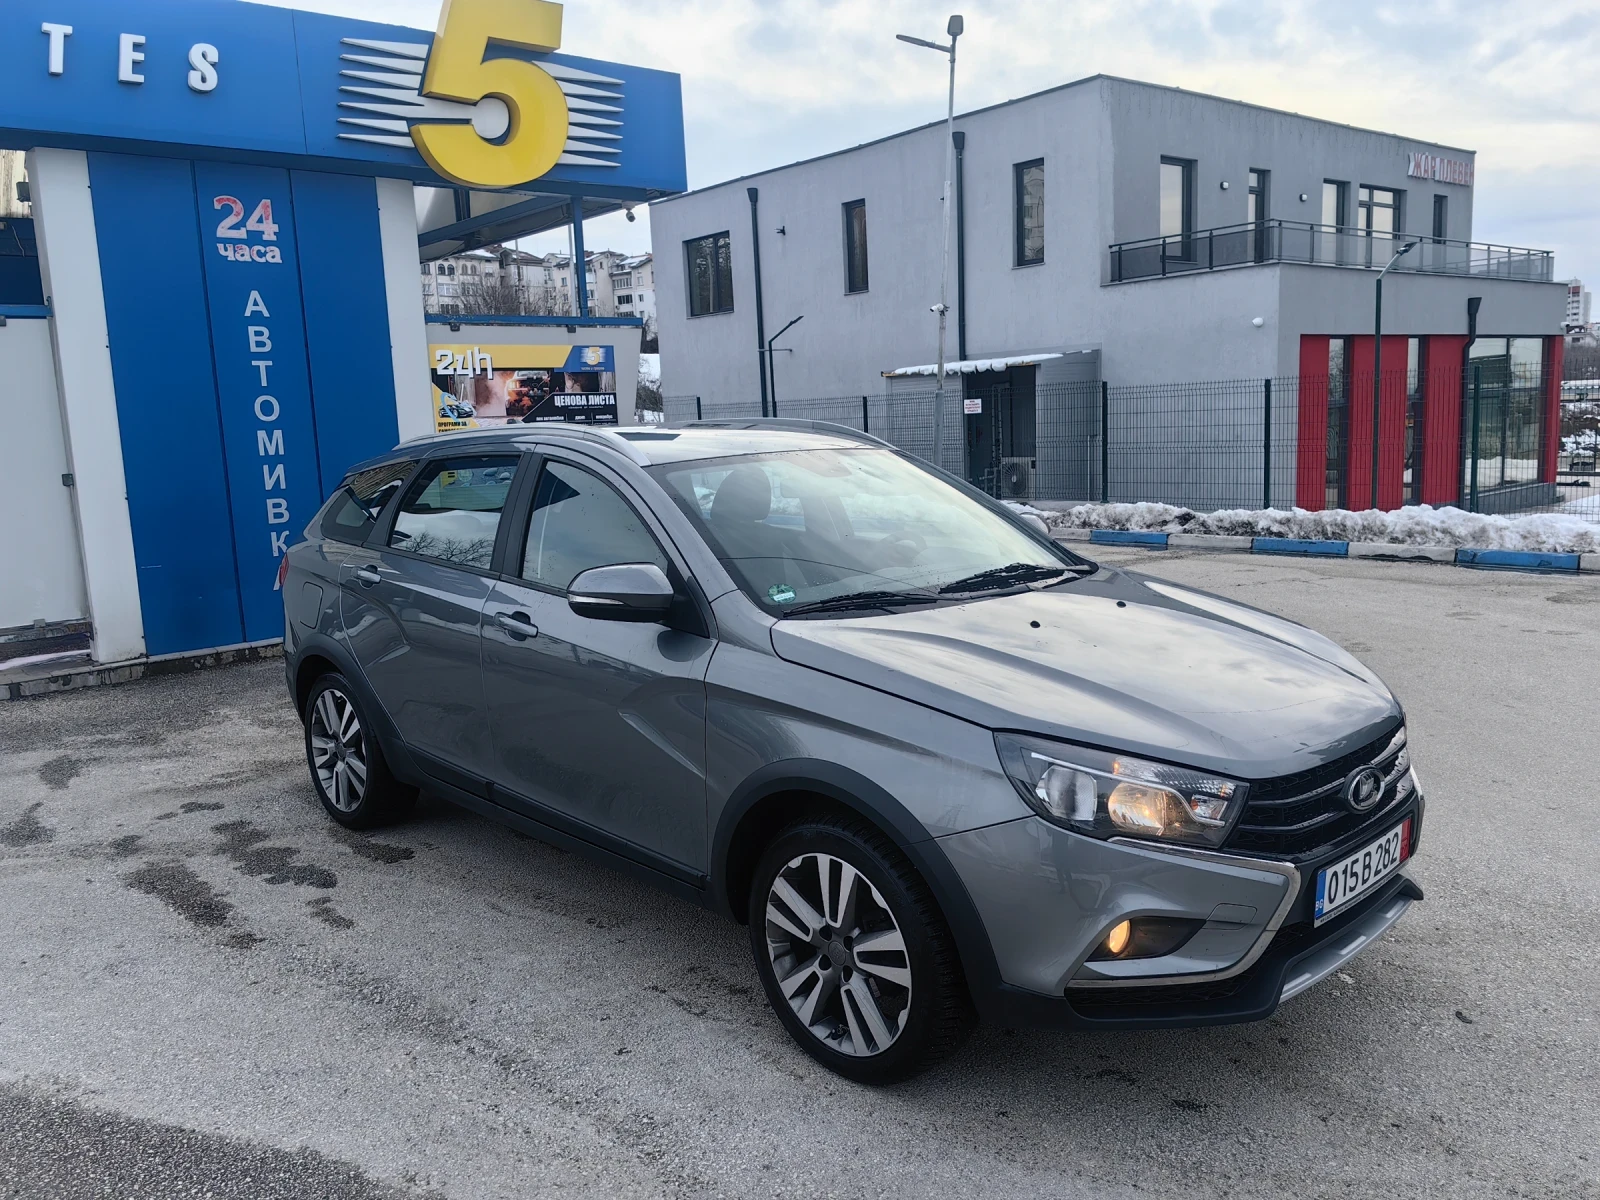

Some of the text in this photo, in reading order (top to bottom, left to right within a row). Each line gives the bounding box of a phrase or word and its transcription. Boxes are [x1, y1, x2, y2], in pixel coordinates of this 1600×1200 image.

[409, 0, 569, 189] 5
[1408, 152, 1474, 185] ЖАР ПЛЕВЕН
[213, 195, 279, 241] 24
[216, 243, 283, 264] часа
[436, 346, 494, 381] 24h
[585, 346, 601, 366] 5
[554, 394, 616, 407] ЦЕНОВА ЛИСТА
[244, 290, 290, 590] АВТОМИВК
[1315, 898, 1324, 910] BG
